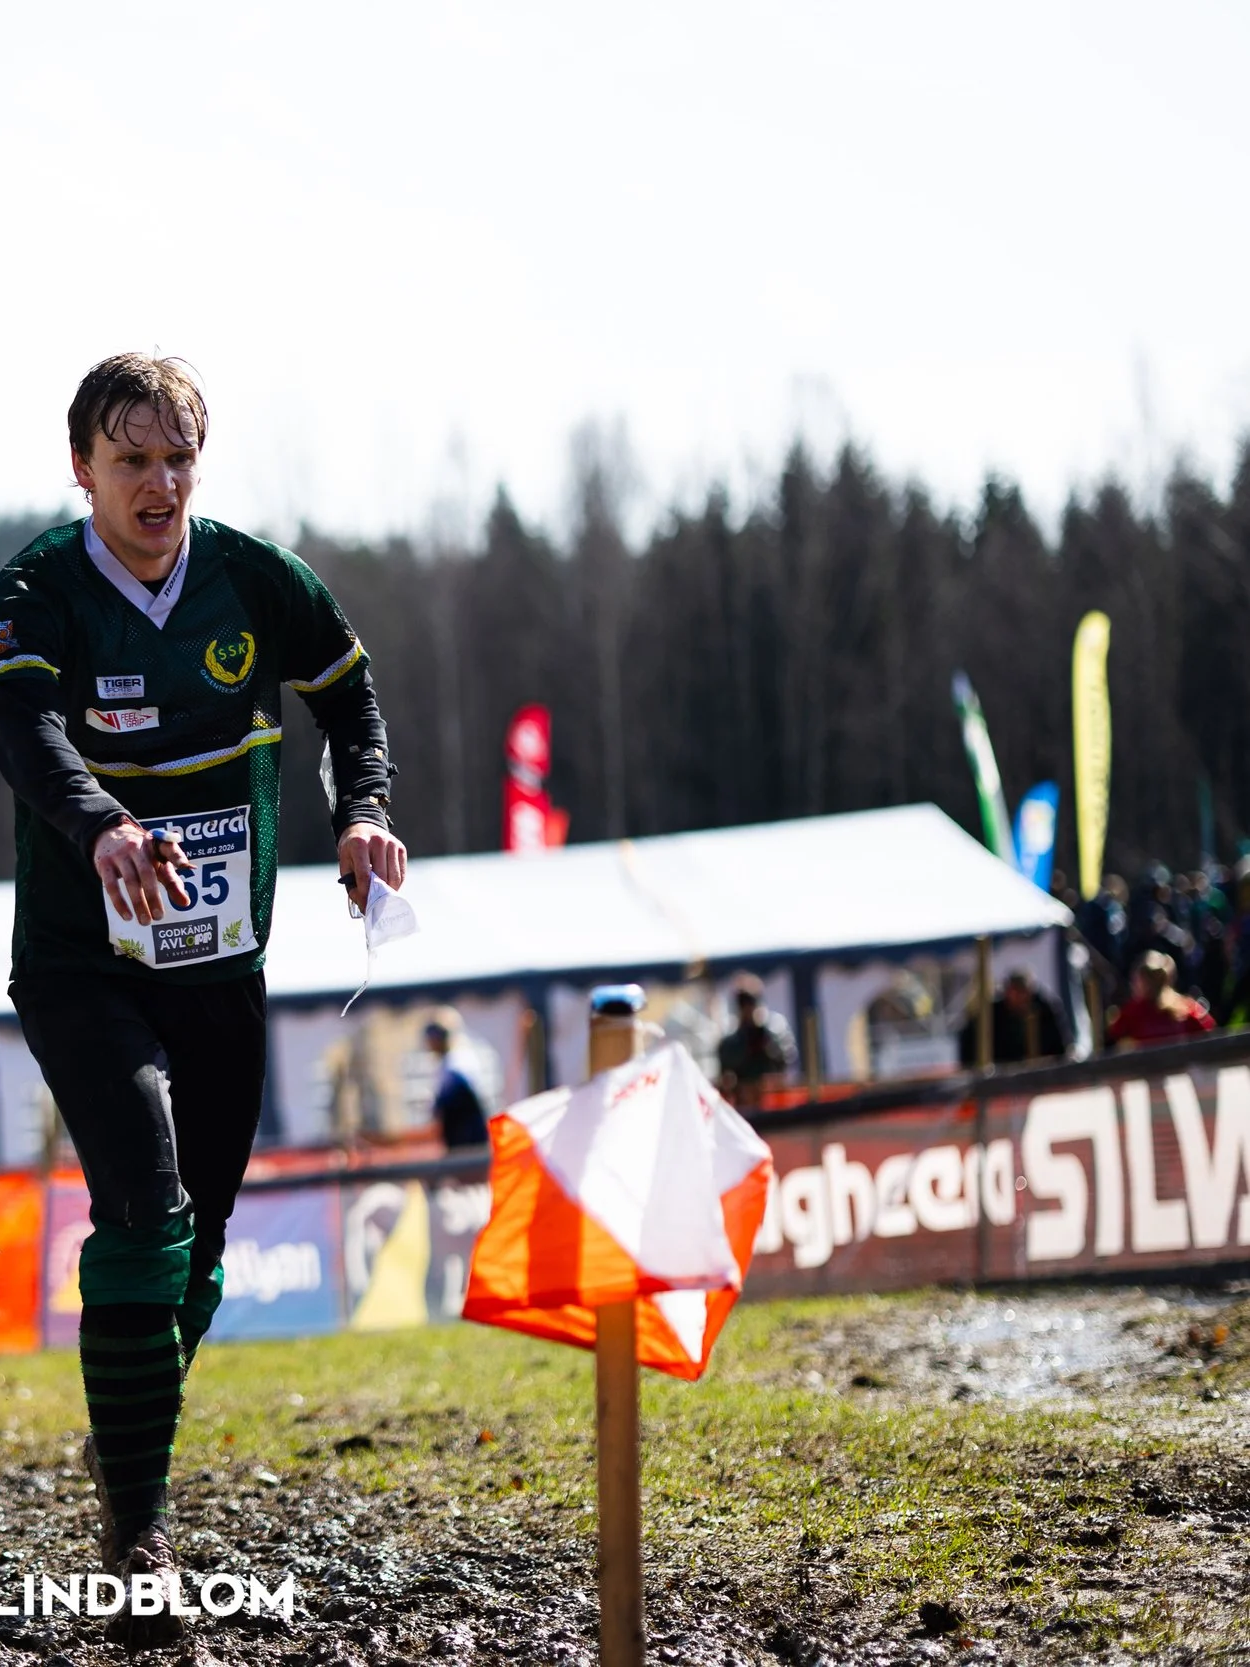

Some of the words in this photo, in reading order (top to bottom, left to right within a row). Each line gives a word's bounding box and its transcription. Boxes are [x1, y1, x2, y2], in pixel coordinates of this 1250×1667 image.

[218, 642, 246, 661] SSK
[103, 678, 142, 688] TIGER
[121, 712, 138, 721] FEEL
[126, 718, 145, 728] GRIP
[207, 846, 217, 854] #2
[218, 843, 235, 853] 2026
[158, 923, 213, 939] GODKÄNDA
[160, 931, 213, 951] AVLOPP
